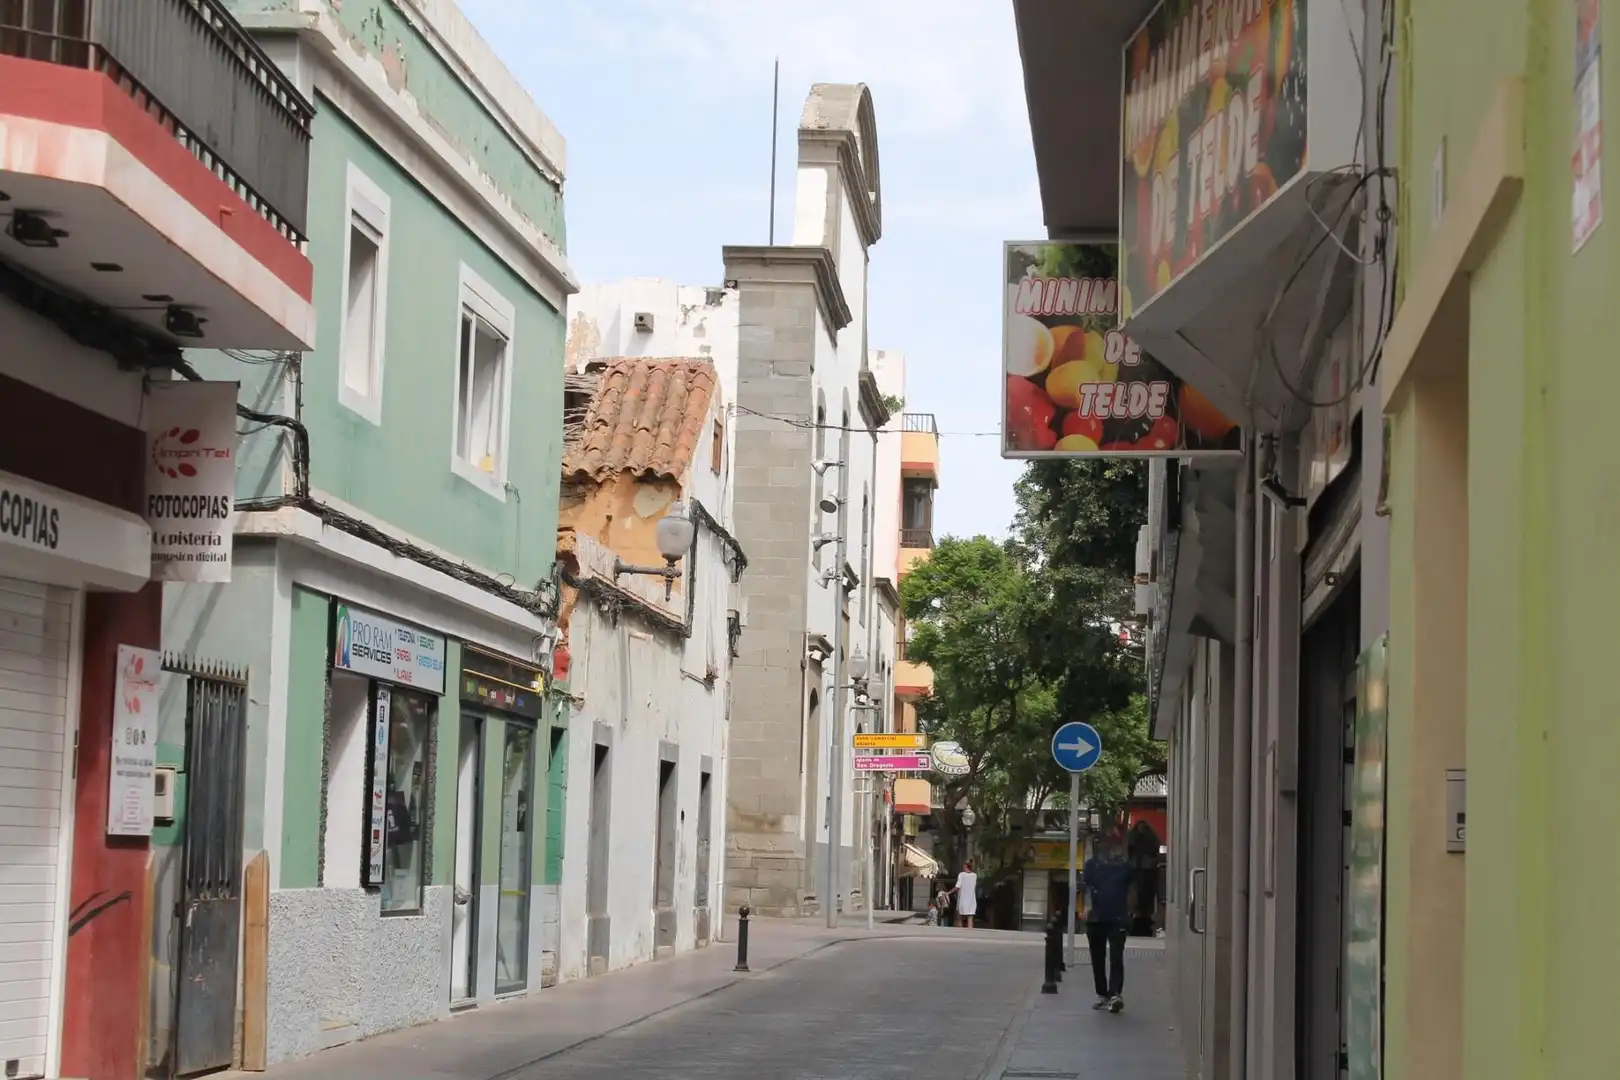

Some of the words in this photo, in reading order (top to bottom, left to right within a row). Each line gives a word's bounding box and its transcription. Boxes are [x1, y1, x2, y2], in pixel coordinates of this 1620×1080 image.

[1151, 152, 1179, 256] DE
[1186, 63, 1265, 230] TELDE
[1104, 329, 1142, 367] DE
[1078, 381, 1169, 419] TELDE
[0, 489, 60, 550] COPIAS
[148, 493, 229, 520] FOTOCOPIAS
[195, 551, 227, 562] digital
[352, 620, 371, 645] PRO
[373, 626, 392, 651] RAM
[352, 643, 392, 665] SERVICES
